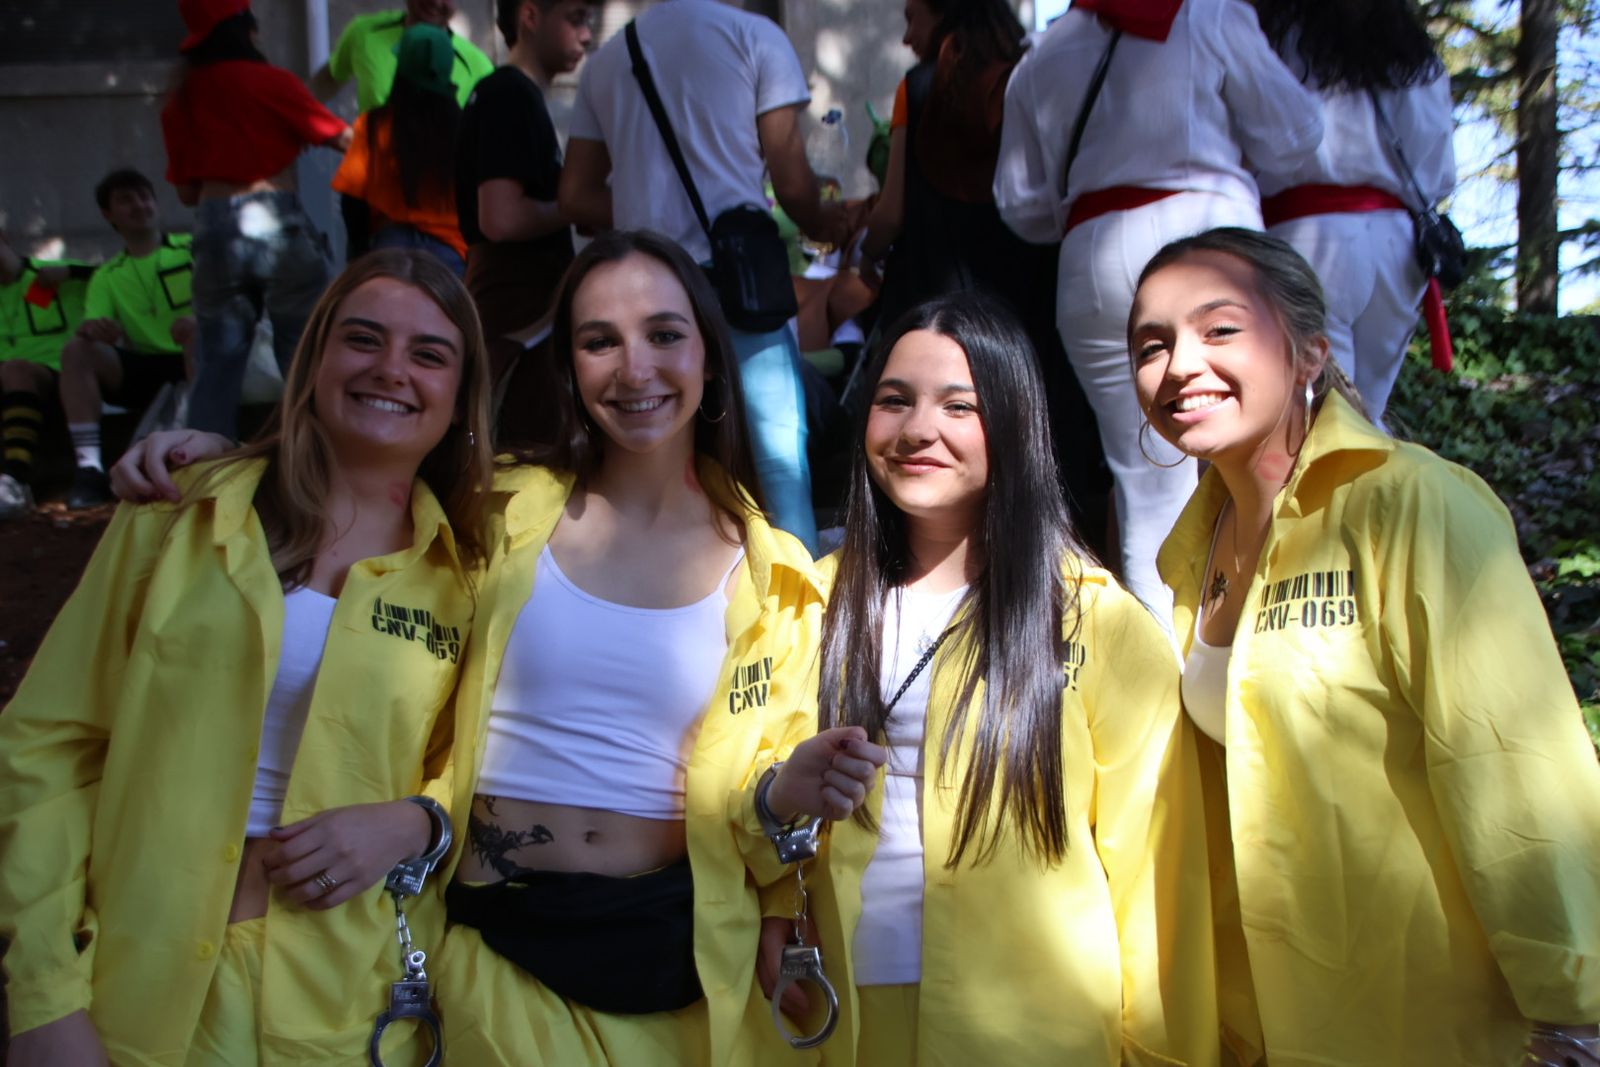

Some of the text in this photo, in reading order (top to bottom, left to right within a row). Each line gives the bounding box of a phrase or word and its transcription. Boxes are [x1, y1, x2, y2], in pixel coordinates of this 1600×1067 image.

[1255, 600, 1354, 633] CNV-069
[372, 614, 460, 664] CNV-069
[729, 683, 769, 715] CNV
